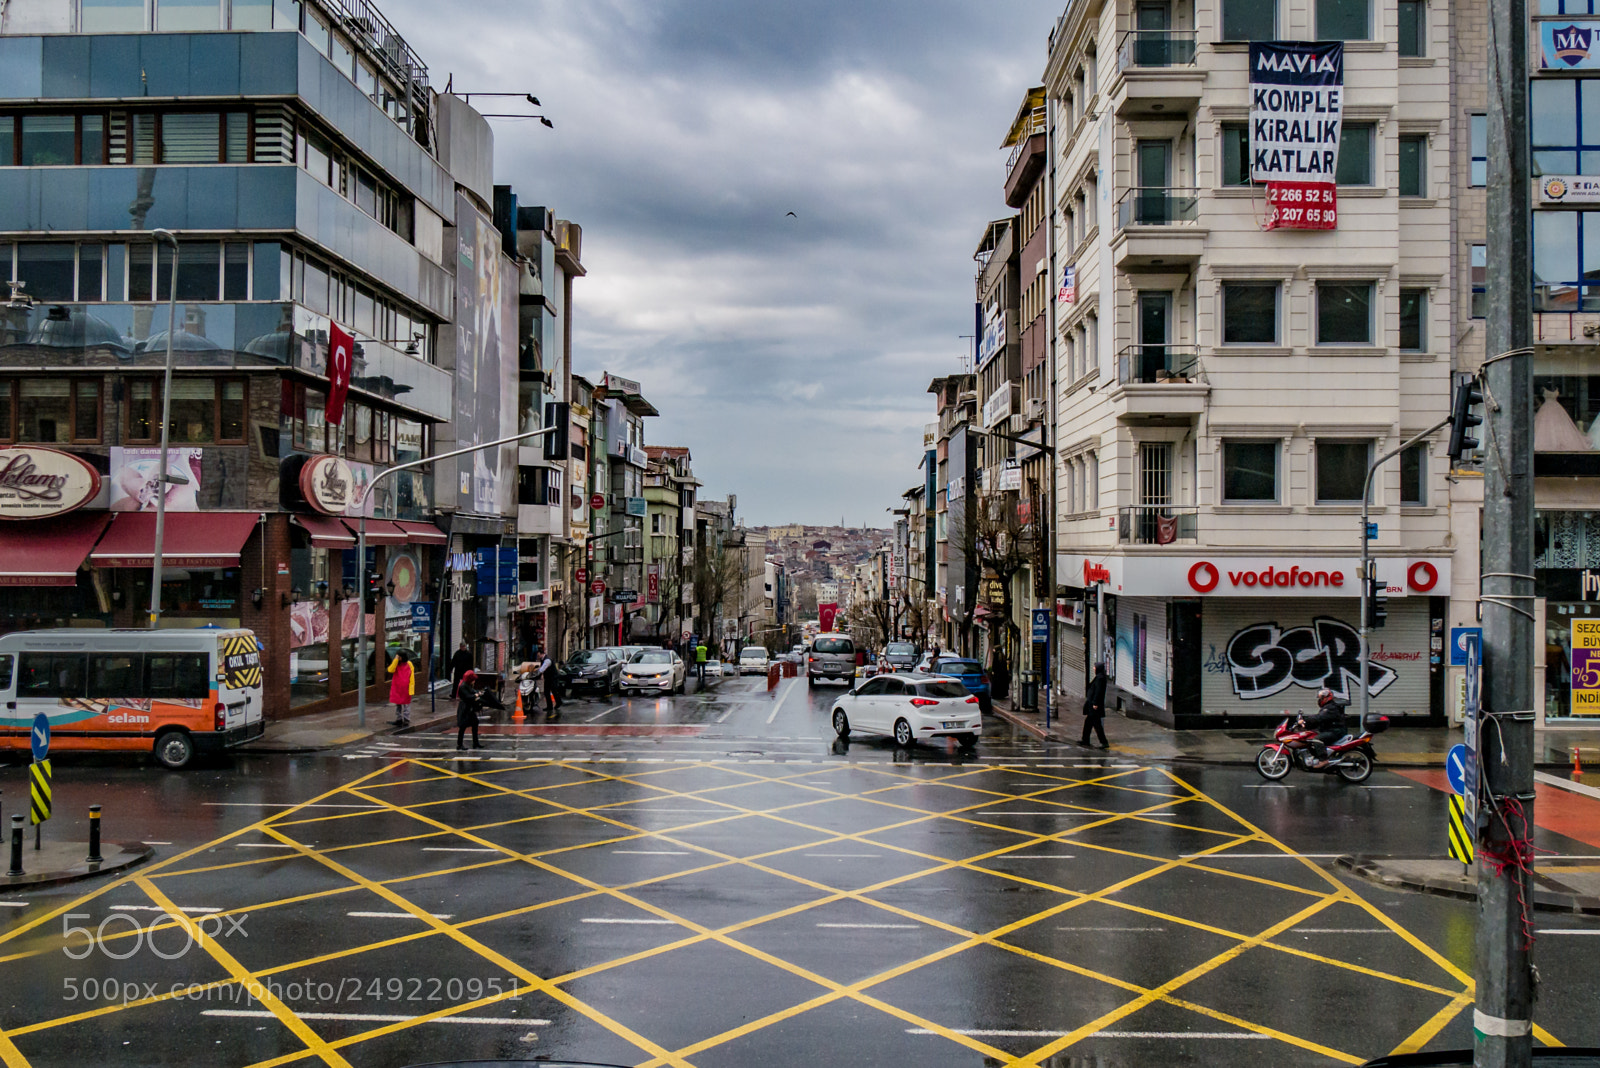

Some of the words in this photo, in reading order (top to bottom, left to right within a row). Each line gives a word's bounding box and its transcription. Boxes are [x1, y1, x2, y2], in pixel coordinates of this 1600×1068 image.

[1254, 88, 1339, 113] KOMPLE
[1254, 148, 1335, 174] KATLAR
[1281, 189, 1303, 202] 266
[1305, 189, 1320, 202] 52
[1282, 208, 1304, 221] 207
[1306, 209, 1321, 222] 65
[1228, 565, 1344, 587] vodafone
[229, 655, 244, 668] OKUL
[108, 713, 149, 723] selam
